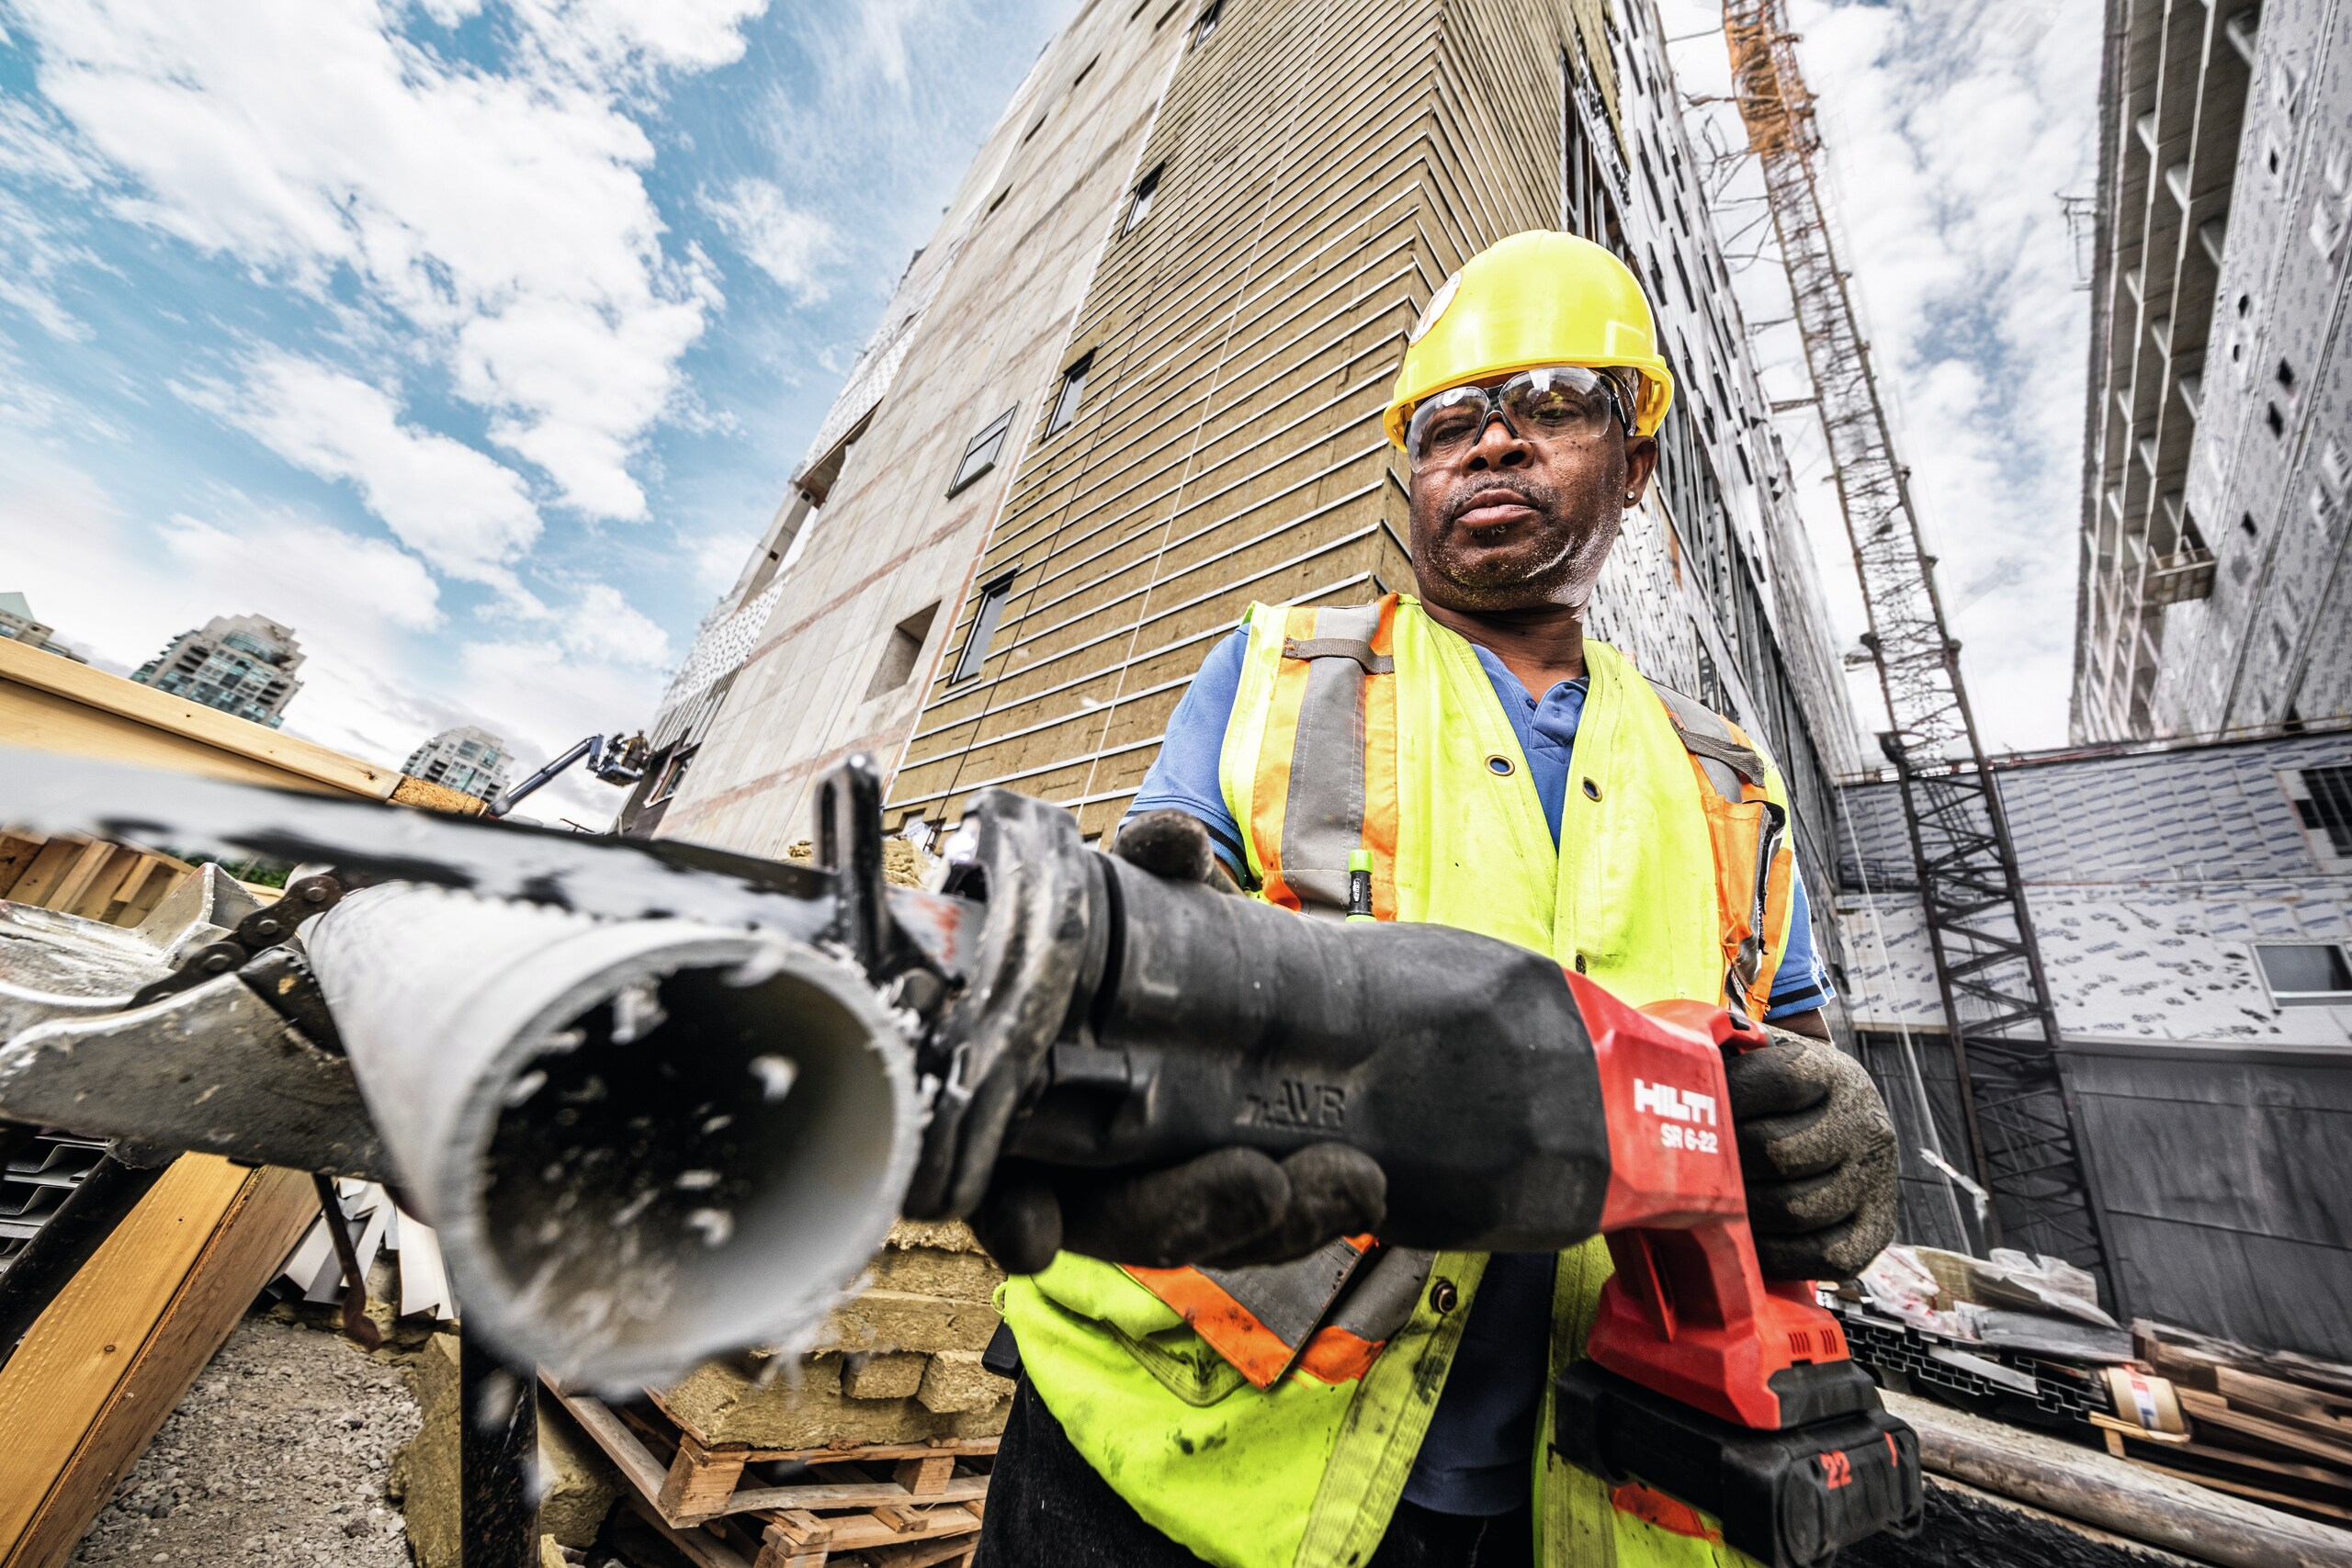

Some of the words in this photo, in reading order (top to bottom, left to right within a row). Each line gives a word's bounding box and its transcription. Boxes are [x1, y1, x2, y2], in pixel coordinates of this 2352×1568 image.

[1634, 1077, 1716, 1126] HILTI
[1660, 1122, 1683, 1148] SR
[1684, 1127, 1719, 1155] 6-22
[1820, 1450, 1852, 1490] 22
